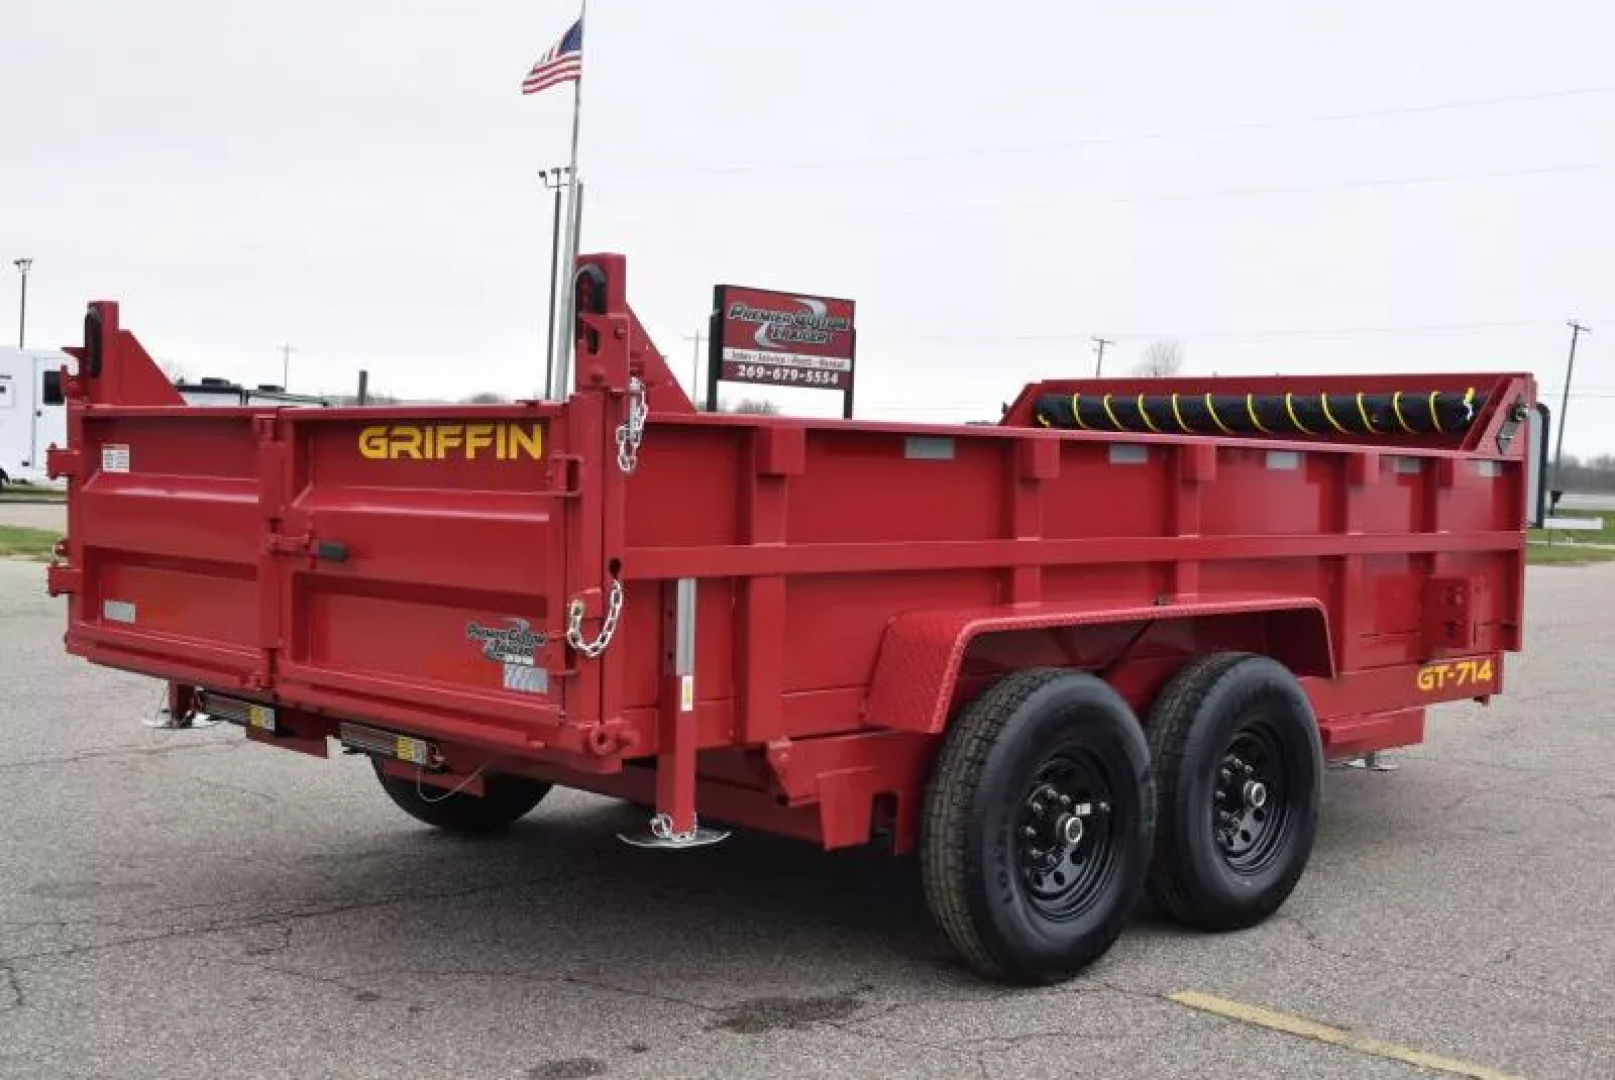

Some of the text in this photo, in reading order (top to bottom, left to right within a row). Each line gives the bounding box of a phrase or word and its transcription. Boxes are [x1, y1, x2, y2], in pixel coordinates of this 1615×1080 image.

[738, 365, 838, 384] 269-679-5554
[358, 425, 542, 459] GRIFFIN
[1418, 658, 1493, 691] GT-714
